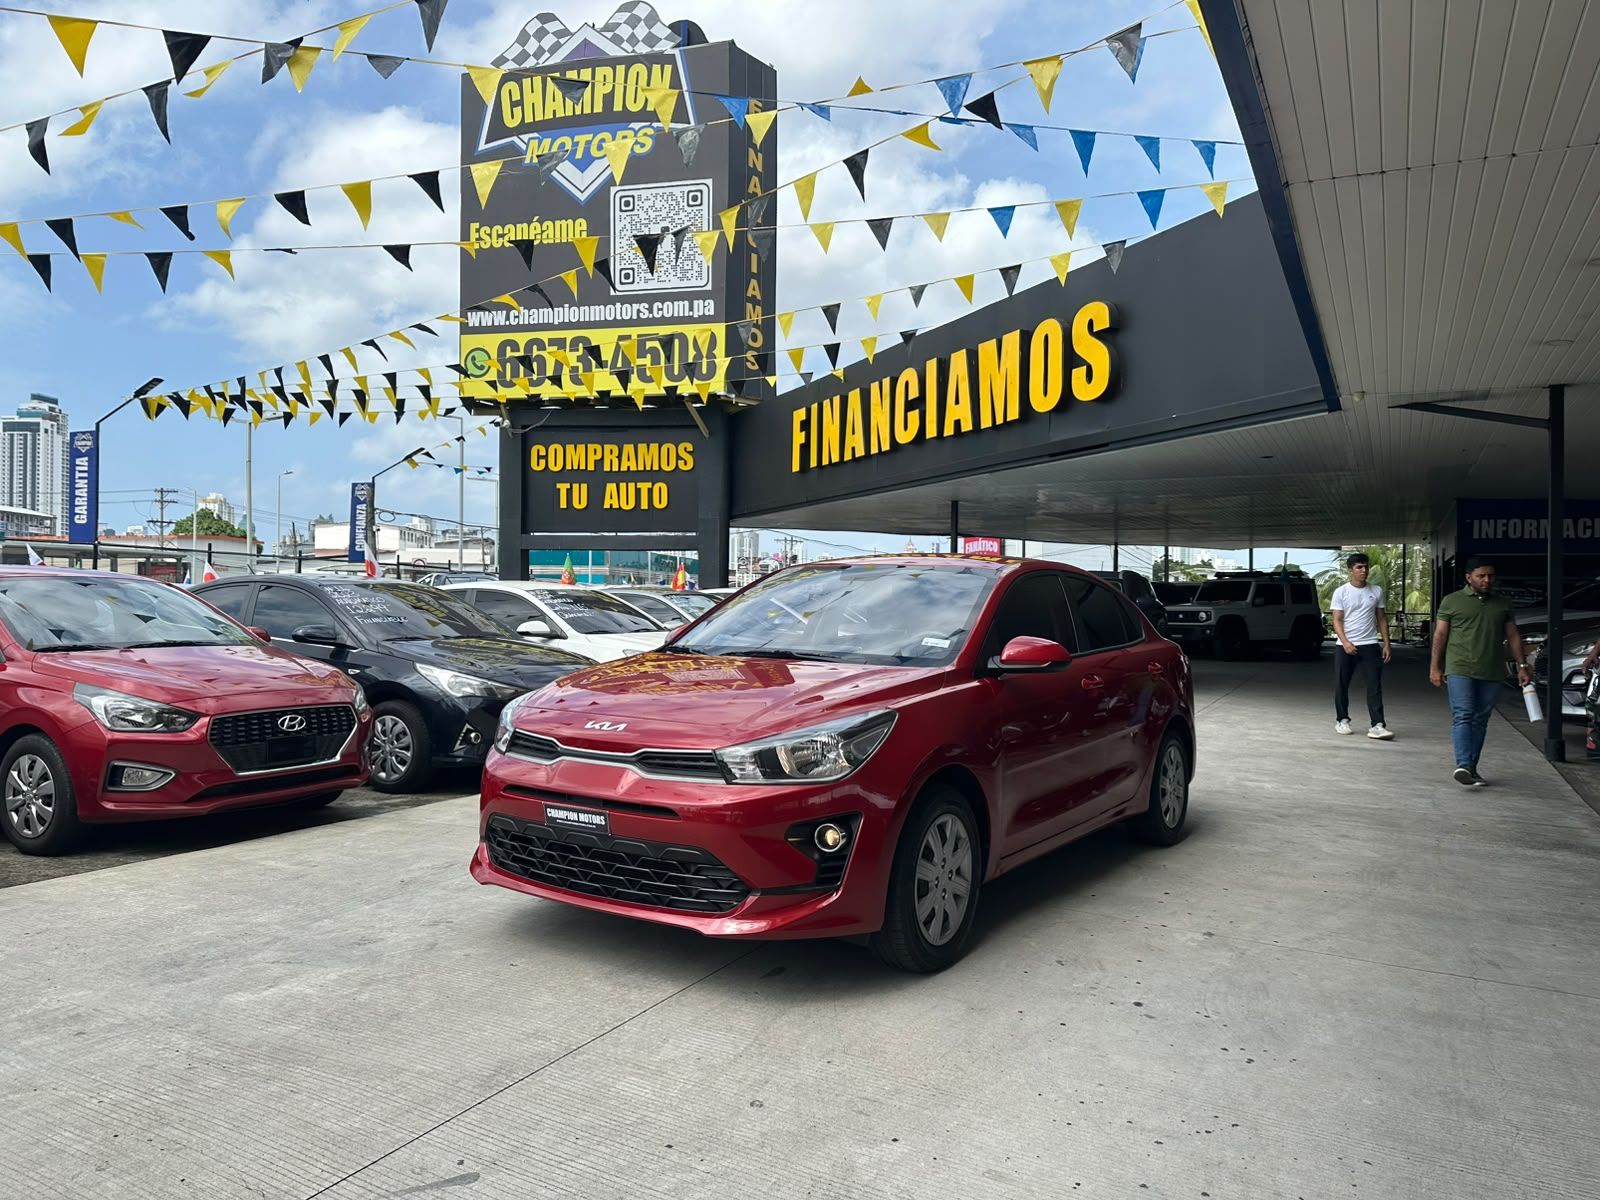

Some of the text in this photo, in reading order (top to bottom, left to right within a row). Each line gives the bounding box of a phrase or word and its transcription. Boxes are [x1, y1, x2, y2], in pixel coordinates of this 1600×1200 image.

[500, 63, 673, 129] CHAMPION
[469, 216, 587, 249] Escanéame
[467, 299, 715, 326] www.championmotors.com.pa
[496, 330, 718, 389] 6673-4508
[791, 300, 1111, 473] FINANCIAMOS
[530, 442, 695, 472] COMPRAMOS
[74, 456, 89, 524] GARANTIA
[556, 482, 669, 510] TU AUTO
[354, 503, 367, 552] CONFIANZA
[584, 720, 628, 732] KIA
[546, 807, 579, 821] CHAMPION
[578, 812, 606, 825] MOTORS
